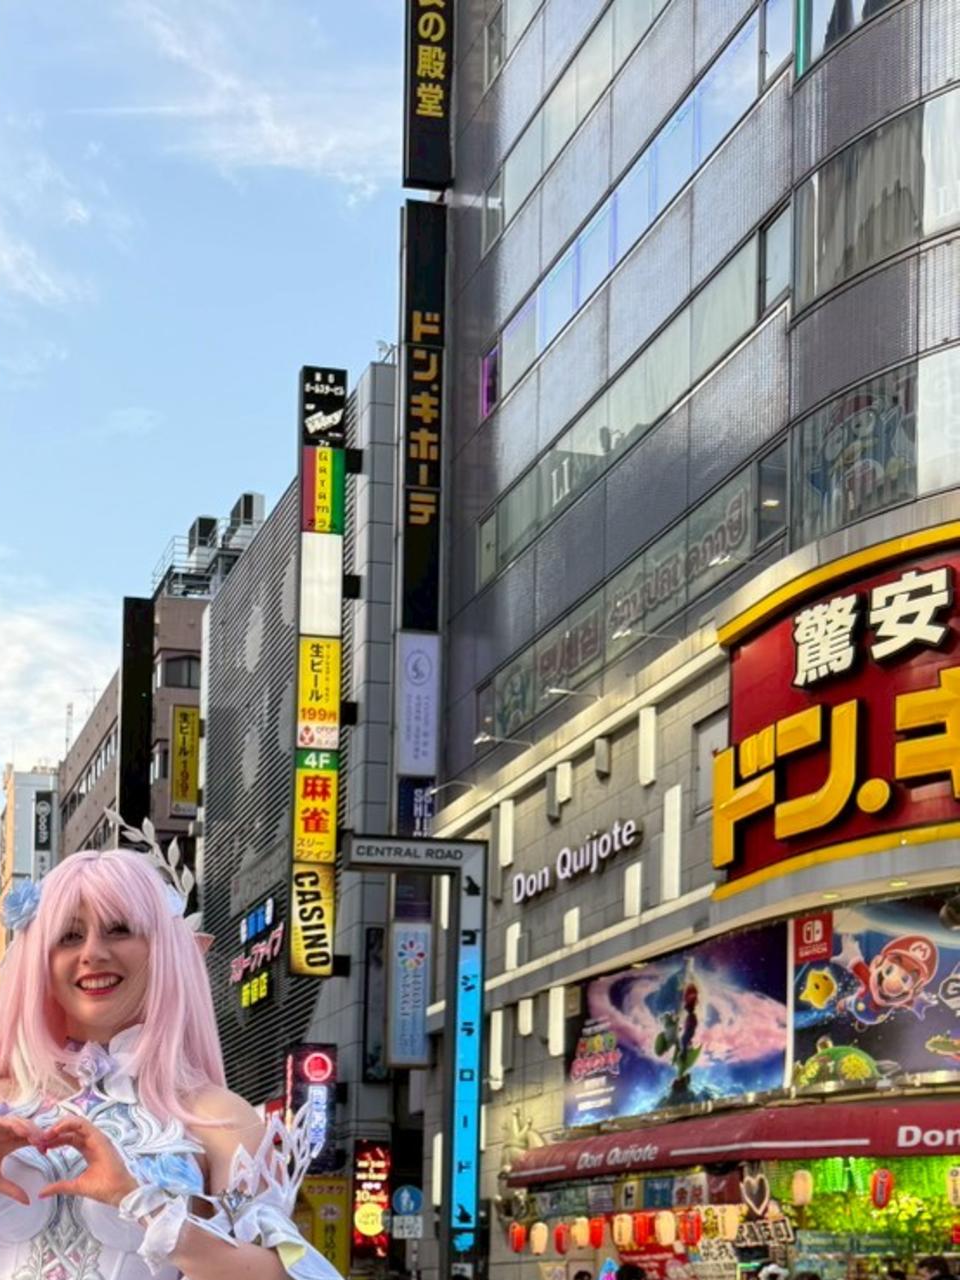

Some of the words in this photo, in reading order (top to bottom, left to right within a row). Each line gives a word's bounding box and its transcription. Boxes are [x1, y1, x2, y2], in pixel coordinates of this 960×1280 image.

[416, 0, 446, 118] の殿堂
[792, 567, 949, 687] 驚安
[309, 643, 324, 702] 生ビール
[304, 753, 331, 769] 4F
[300, 775, 332, 833] 麻雀
[356, 845, 421, 859] CENTRAL
[425, 847, 463, 860] ROAD
[512, 866, 549, 904] Don
[556, 819, 636, 880] Quijote
[294, 871, 330, 968] CASINO
[457, 929, 480, 1174] ゴジラロード
[576, 1152, 604, 1170] Don
[606, 1143, 659, 1167] Quijote
[897, 1125, 960, 1148] Don
